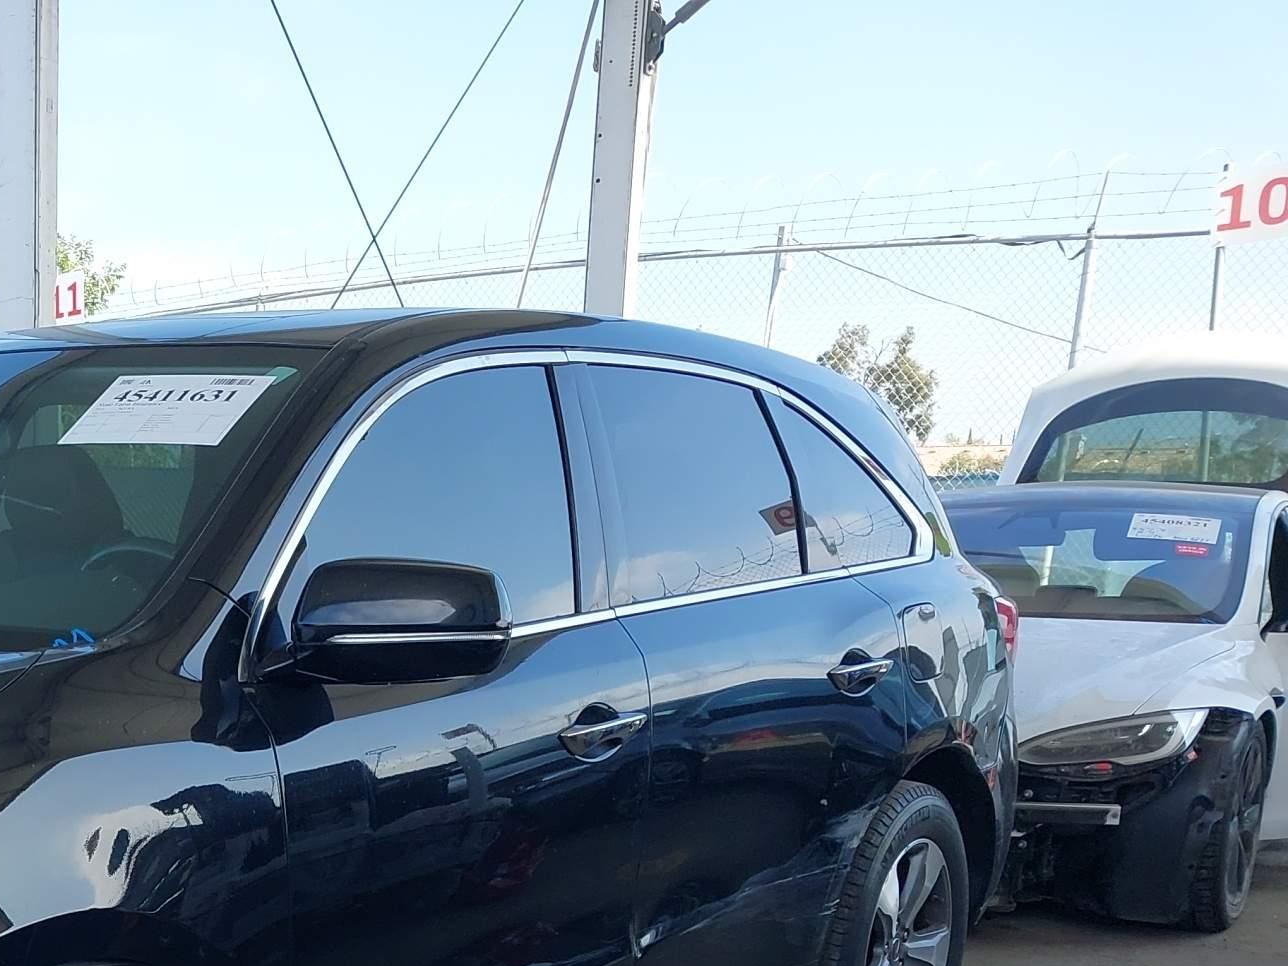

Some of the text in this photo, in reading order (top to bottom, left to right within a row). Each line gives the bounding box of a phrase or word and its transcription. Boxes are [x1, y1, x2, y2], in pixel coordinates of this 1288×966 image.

[1216, 177, 1288, 231] 10
[55, 281, 82, 319] 11
[114, 389, 238, 403] 45411631
